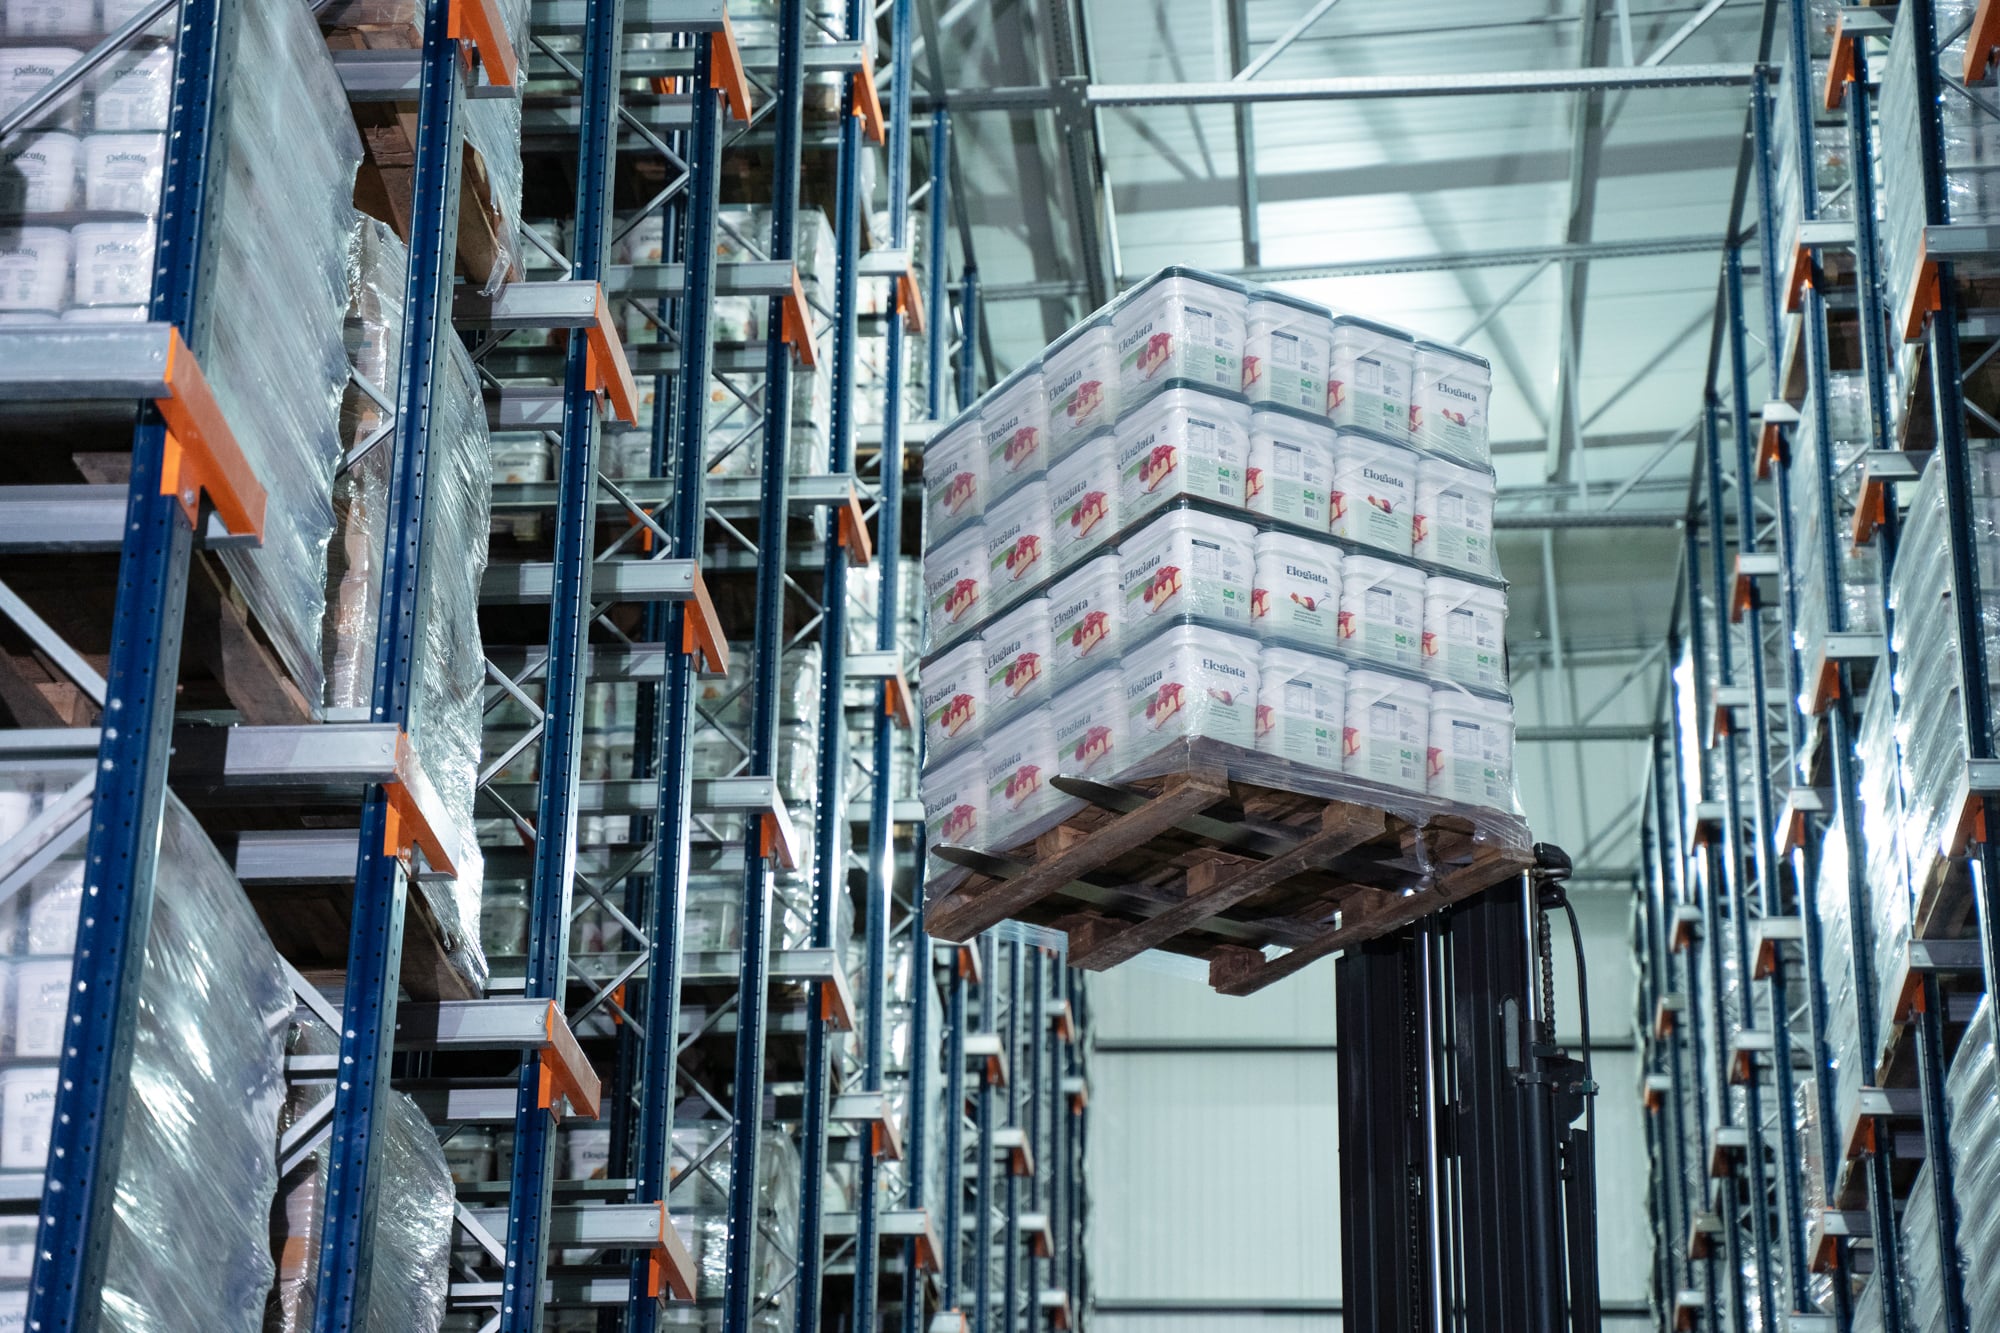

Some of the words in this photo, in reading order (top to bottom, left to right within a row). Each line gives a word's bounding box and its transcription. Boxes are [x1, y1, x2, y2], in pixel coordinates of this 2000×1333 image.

[1118, 322, 1153, 354] Elogiata
[1049, 369, 1082, 398] Elogiata
[1438, 382, 1477, 402] Elogiata
[987, 415, 1019, 445] Elogiata
[1120, 434, 1155, 465] Elogiata
[1363, 468, 1404, 488] Elogiata
[1054, 479, 1087, 510] Elogiata
[989, 523, 1021, 553] Elogiata
[1125, 553, 1161, 586] Elogiata
[1286, 564, 1328, 585] Elogiata
[1054, 598, 1089, 628] Elogiata
[988, 640, 1021, 669] Elogiata
[1202, 658, 1246, 679] Elogiata
[923, 681, 956, 708] Elogiata
[1128, 669, 1163, 699] Elogiata
[1056, 713, 1091, 742] Elogiata
[988, 752, 1022, 780] Elogiata
